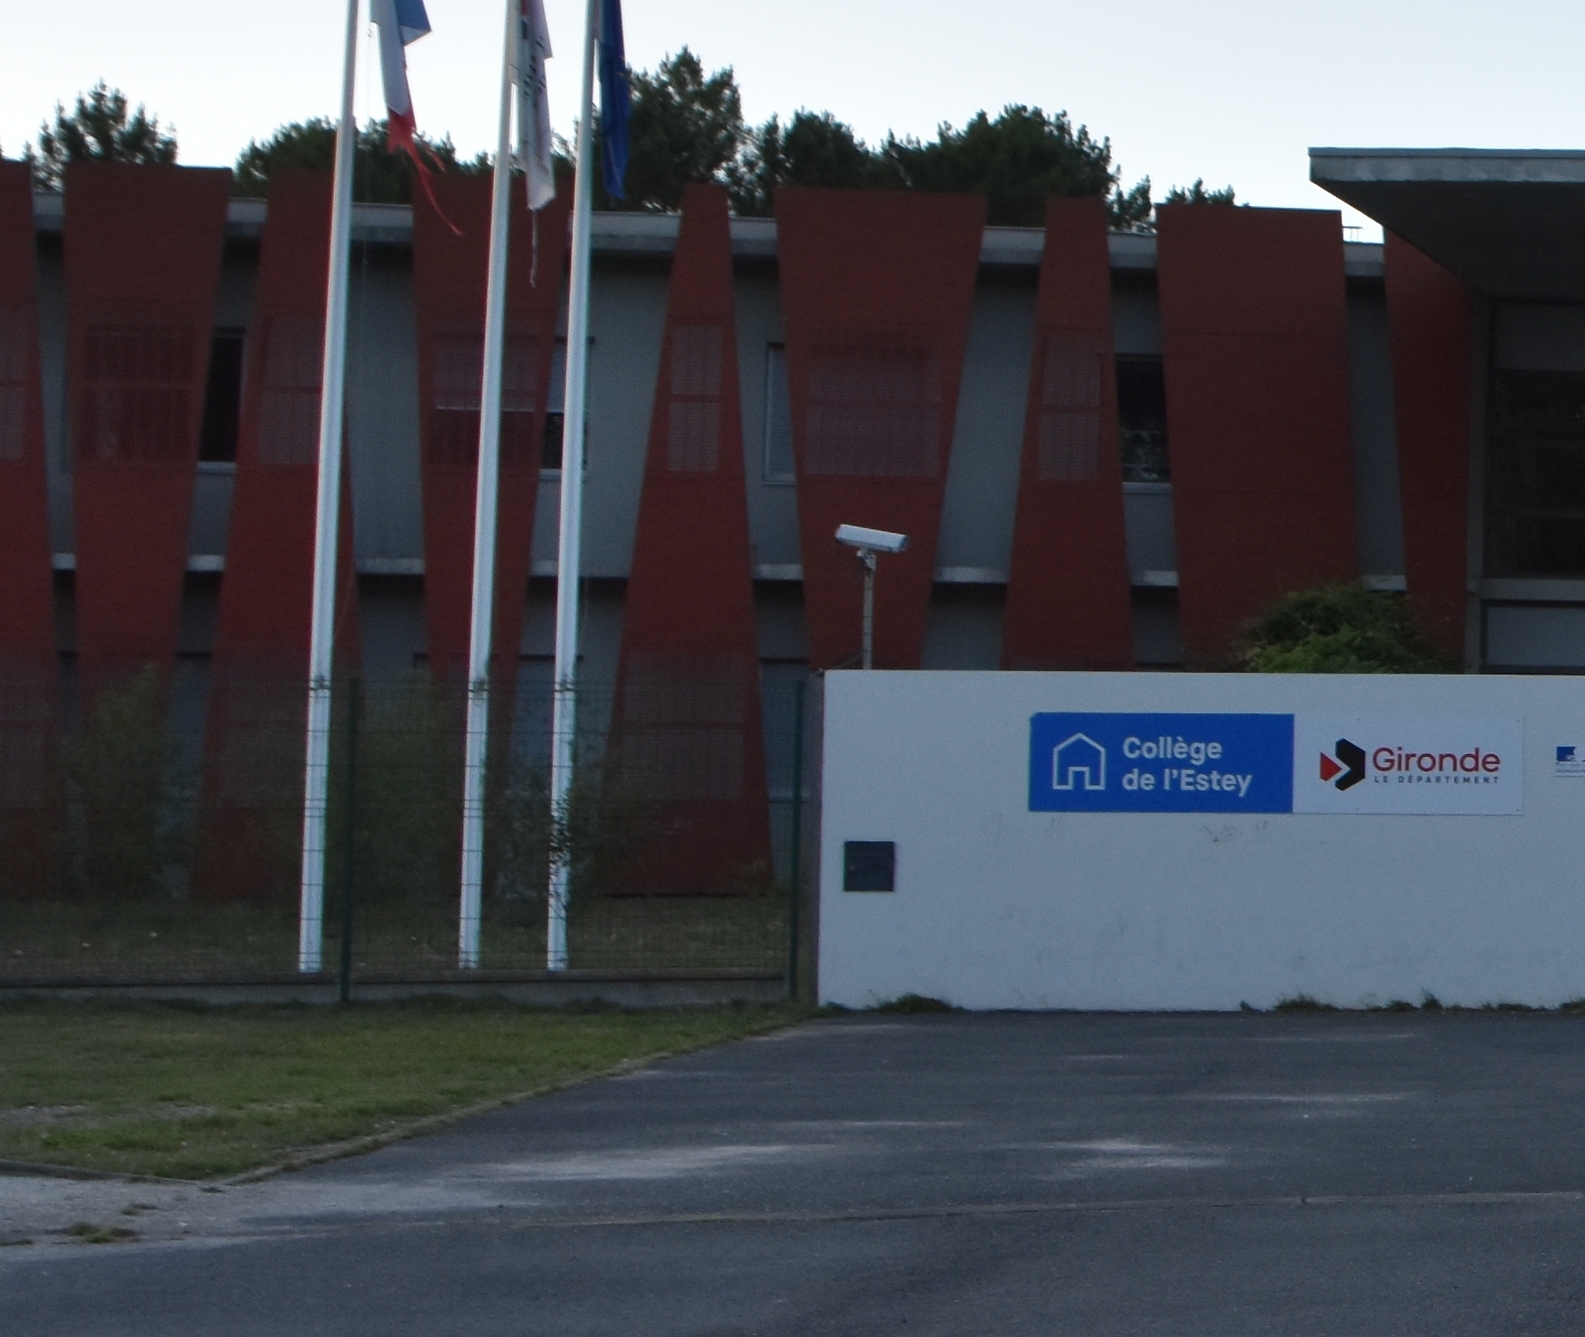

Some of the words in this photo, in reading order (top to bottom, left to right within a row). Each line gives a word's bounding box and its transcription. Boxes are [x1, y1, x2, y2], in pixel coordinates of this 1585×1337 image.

[1122, 736, 1223, 766] Collège
[1372, 746, 1501, 773] Gironde
[1121, 767, 1156, 791] de
[1163, 767, 1253, 798] l’Estey
[1374, 775, 1389, 784] LE
[1397, 774, 1500, 784] DÉPARTEMENT
